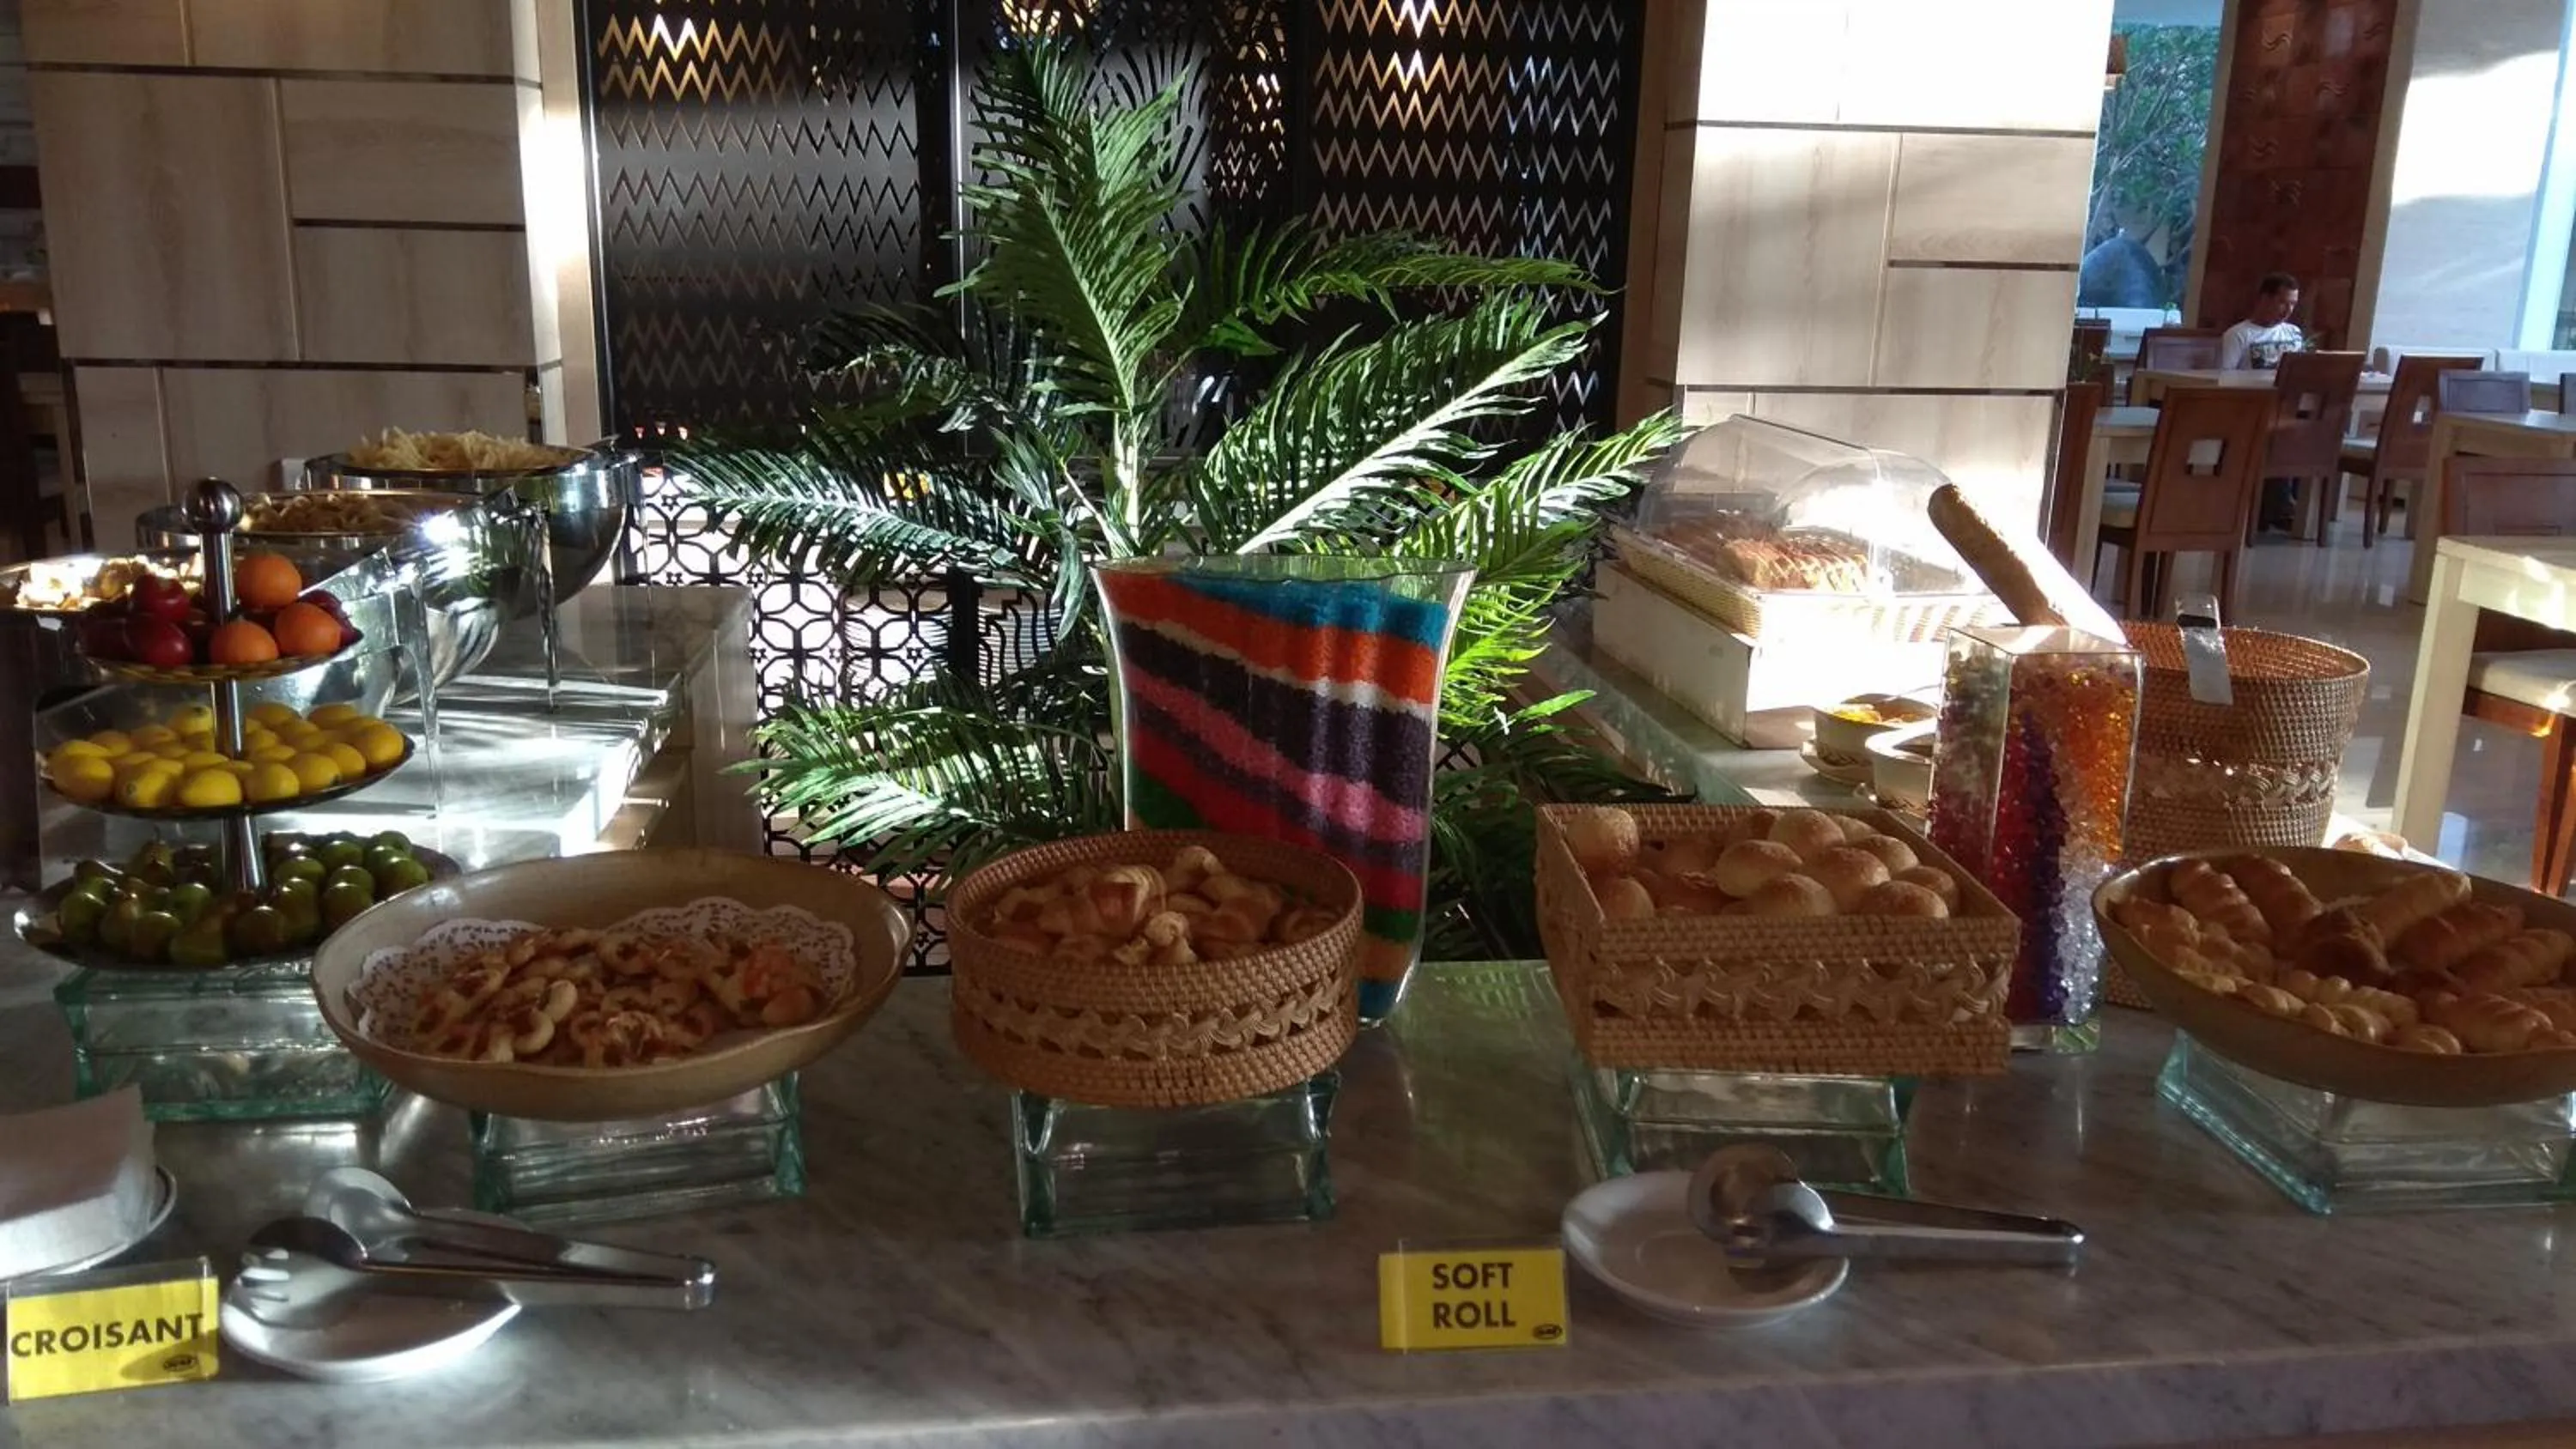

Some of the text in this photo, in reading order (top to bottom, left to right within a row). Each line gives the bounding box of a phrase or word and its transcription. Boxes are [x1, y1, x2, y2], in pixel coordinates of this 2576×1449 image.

[1432, 1263, 1514, 1289] SOFT
[1432, 1300, 1516, 1329] ROLL
[10, 1313, 204, 1357] CROISANT
